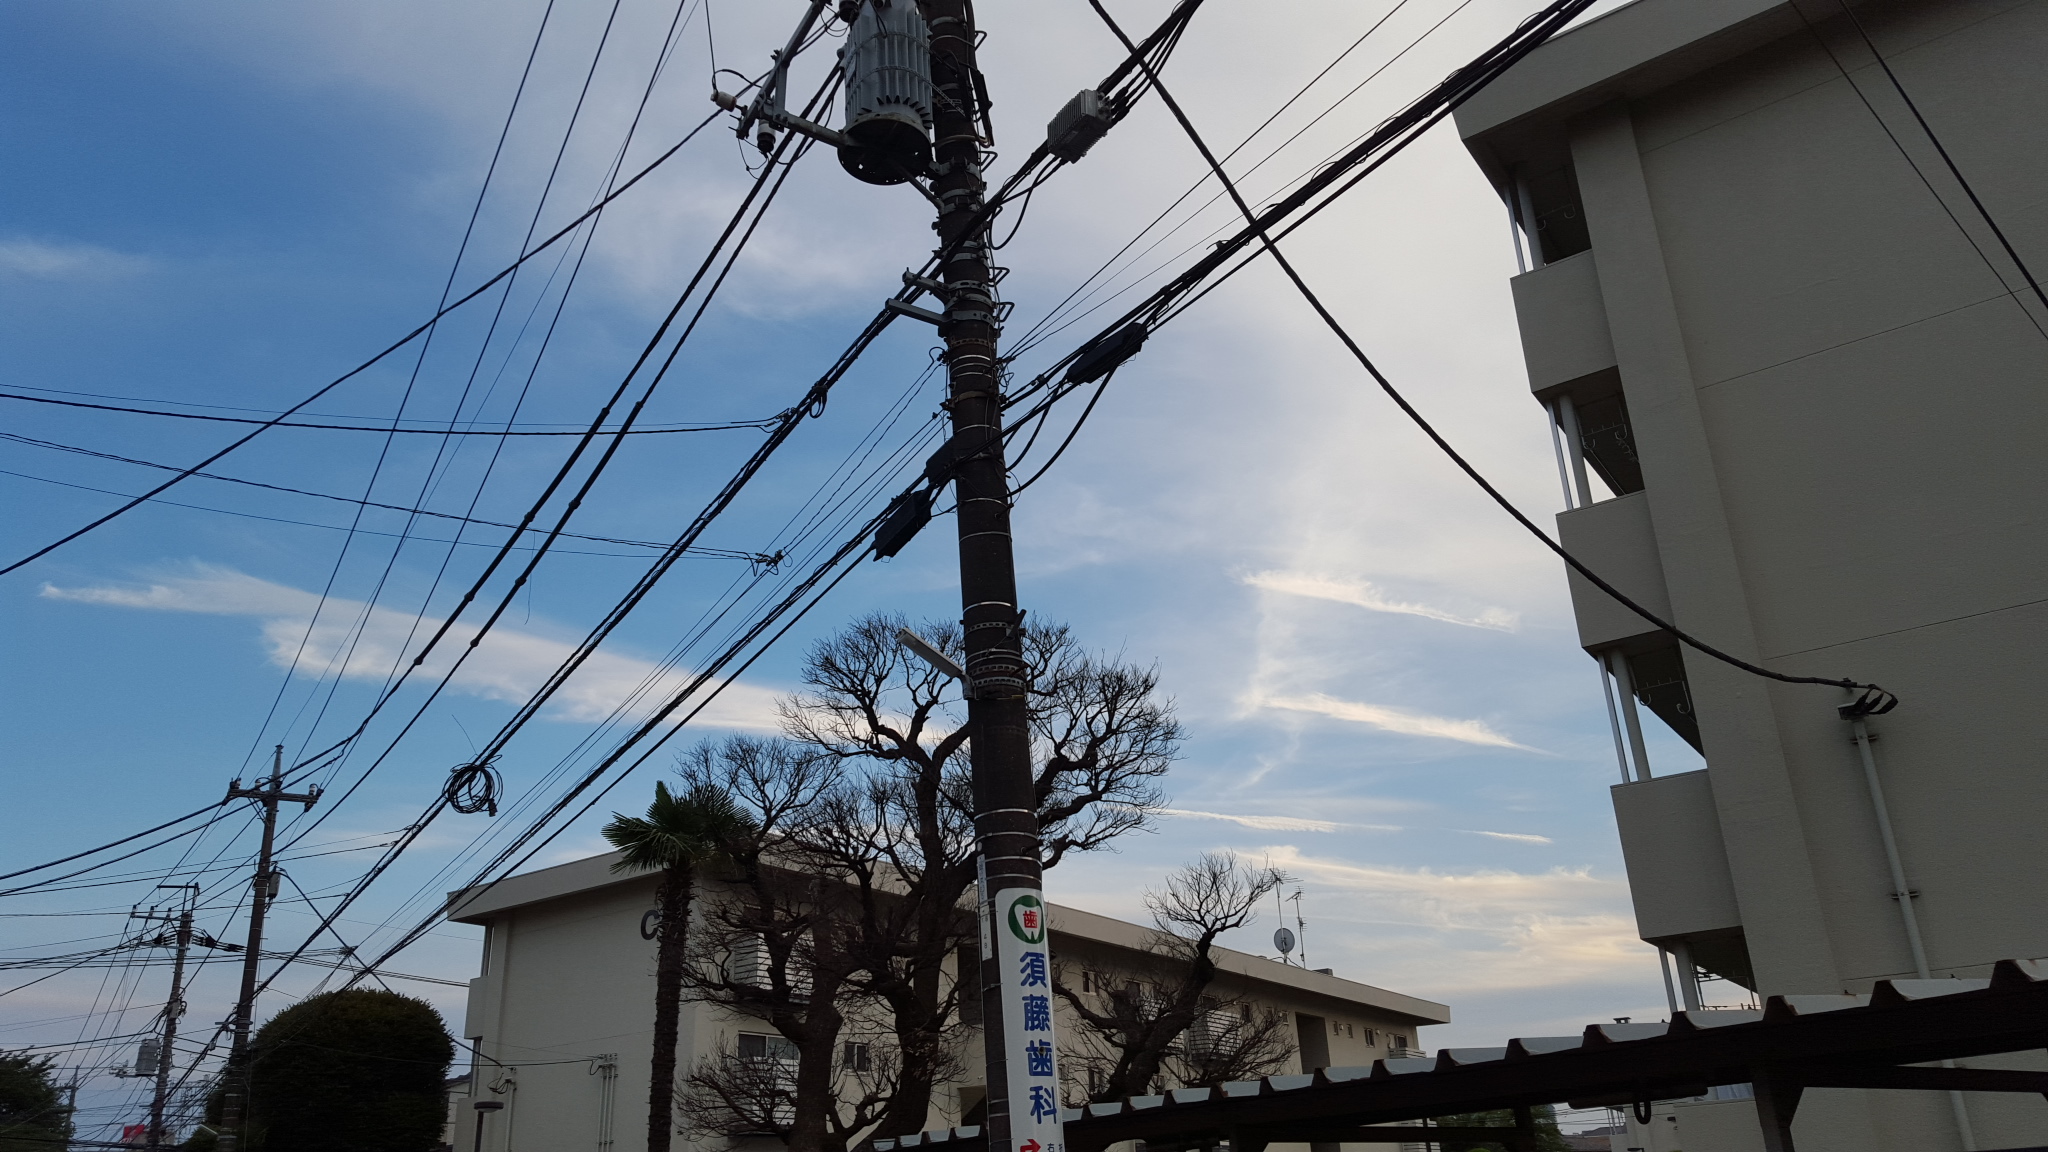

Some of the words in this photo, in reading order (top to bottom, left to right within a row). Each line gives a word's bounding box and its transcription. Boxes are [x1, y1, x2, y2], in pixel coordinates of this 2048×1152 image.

[1022, 909, 1038, 929] 歯
[1020, 951, 1057, 1125] 須藤歯科
